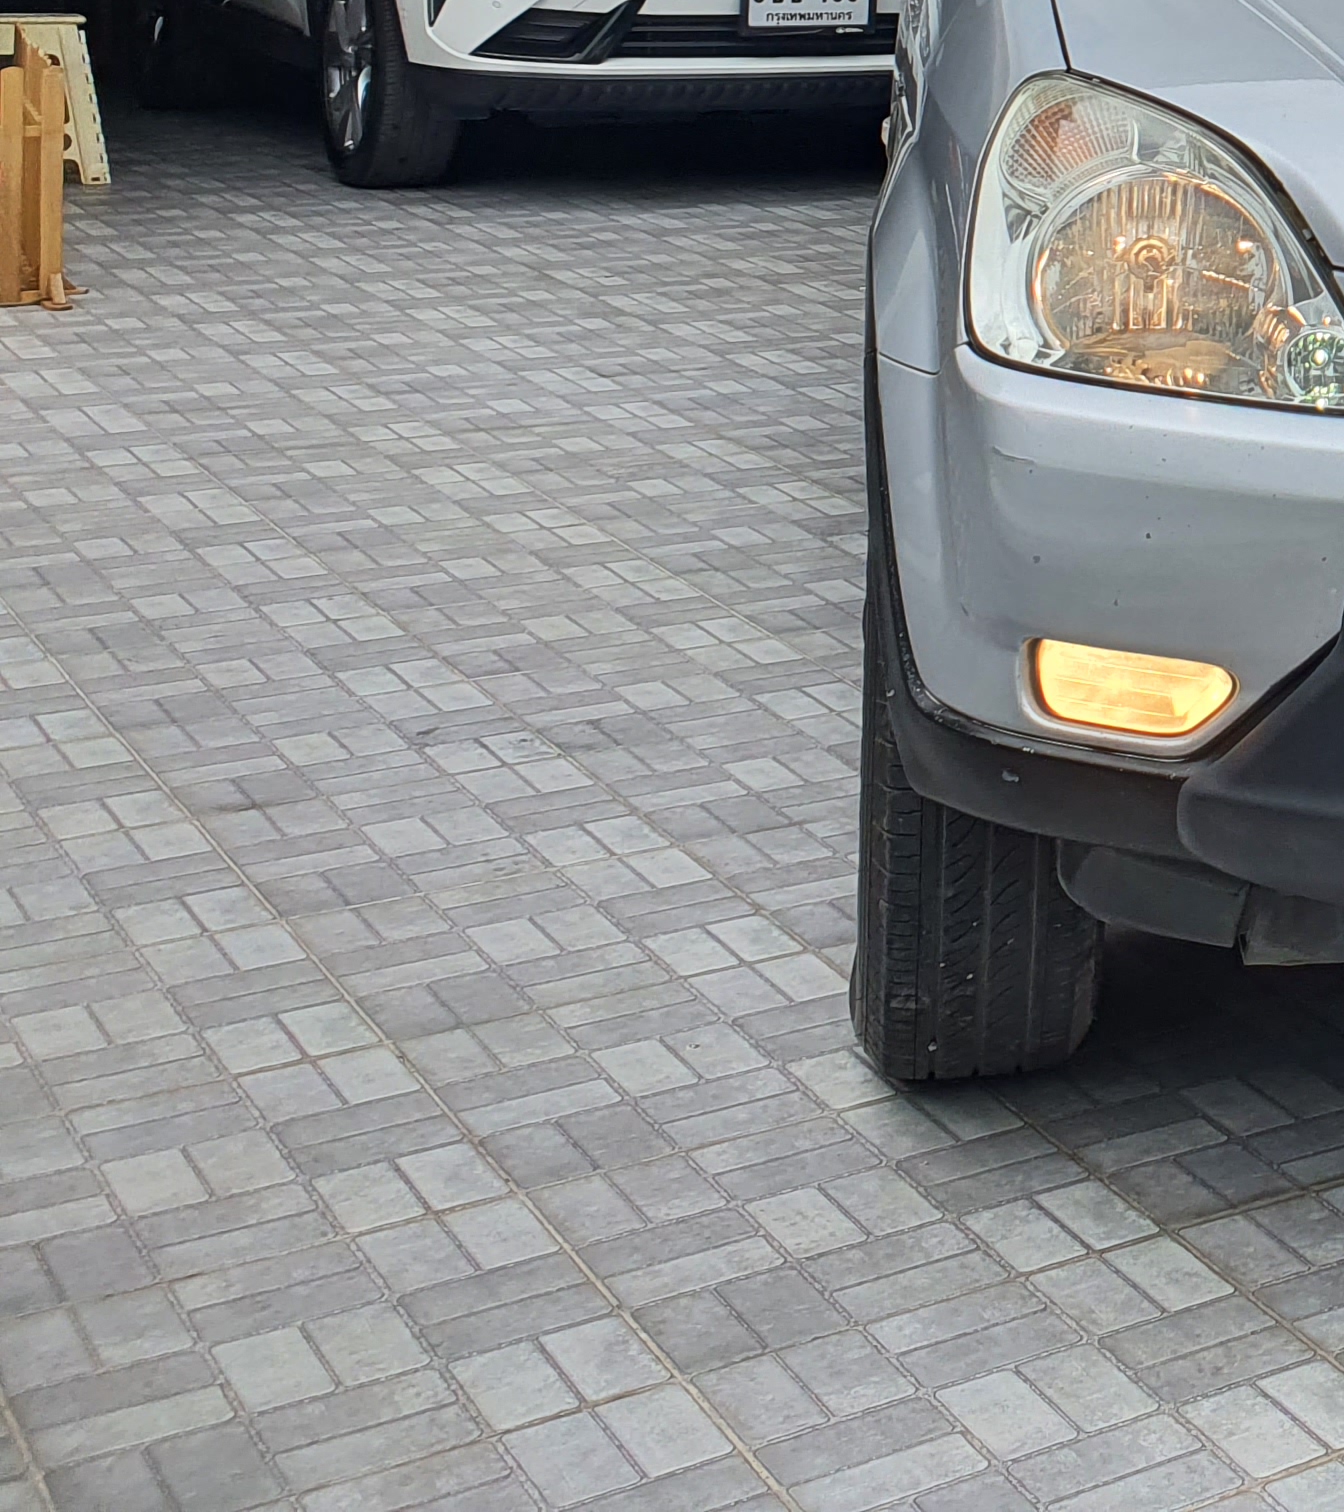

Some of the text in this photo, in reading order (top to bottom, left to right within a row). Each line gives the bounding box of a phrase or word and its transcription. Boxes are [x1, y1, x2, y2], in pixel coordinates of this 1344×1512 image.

[766, 10, 853, 25] กรุงเทพมหานคร
